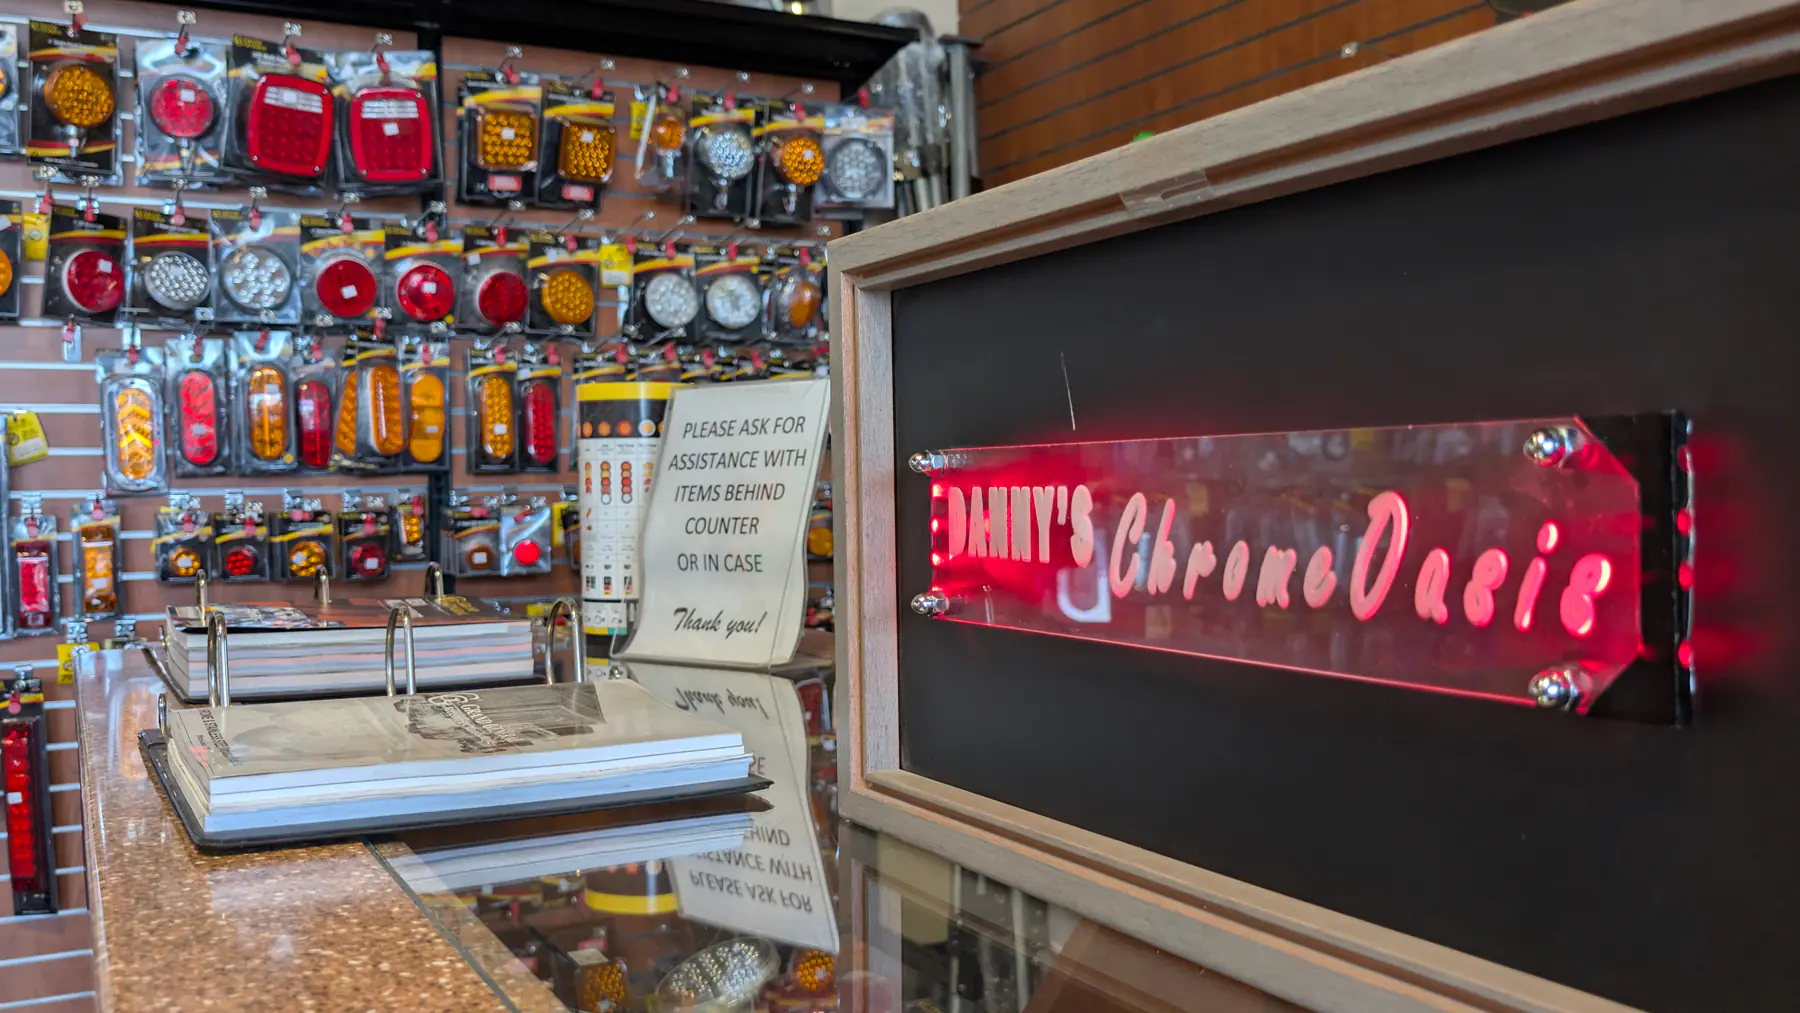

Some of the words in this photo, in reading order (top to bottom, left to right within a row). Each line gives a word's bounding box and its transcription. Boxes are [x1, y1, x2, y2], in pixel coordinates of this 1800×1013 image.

[682, 419, 736, 439] PLEASE
[738, 418, 770, 436] ASK
[773, 416, 806, 434] FOR
[668, 450, 759, 471] ASSISTANCE
[763, 448, 807, 467] WITH
[674, 484, 722, 502] ITEMS
[724, 483, 785, 501] BEHIND
[685, 517, 759, 535] COUNTER
[677, 553, 699, 571] OR
[704, 554, 719, 572] IN
[724, 554, 763, 573] CASE
[947, 484, 1094, 568] DANNY'S
[1109, 491, 1335, 609] Chrome
[1350, 490, 1612, 637] Oasis
[673, 607, 724, 632] Thank
[725, 611, 766, 639] you!
